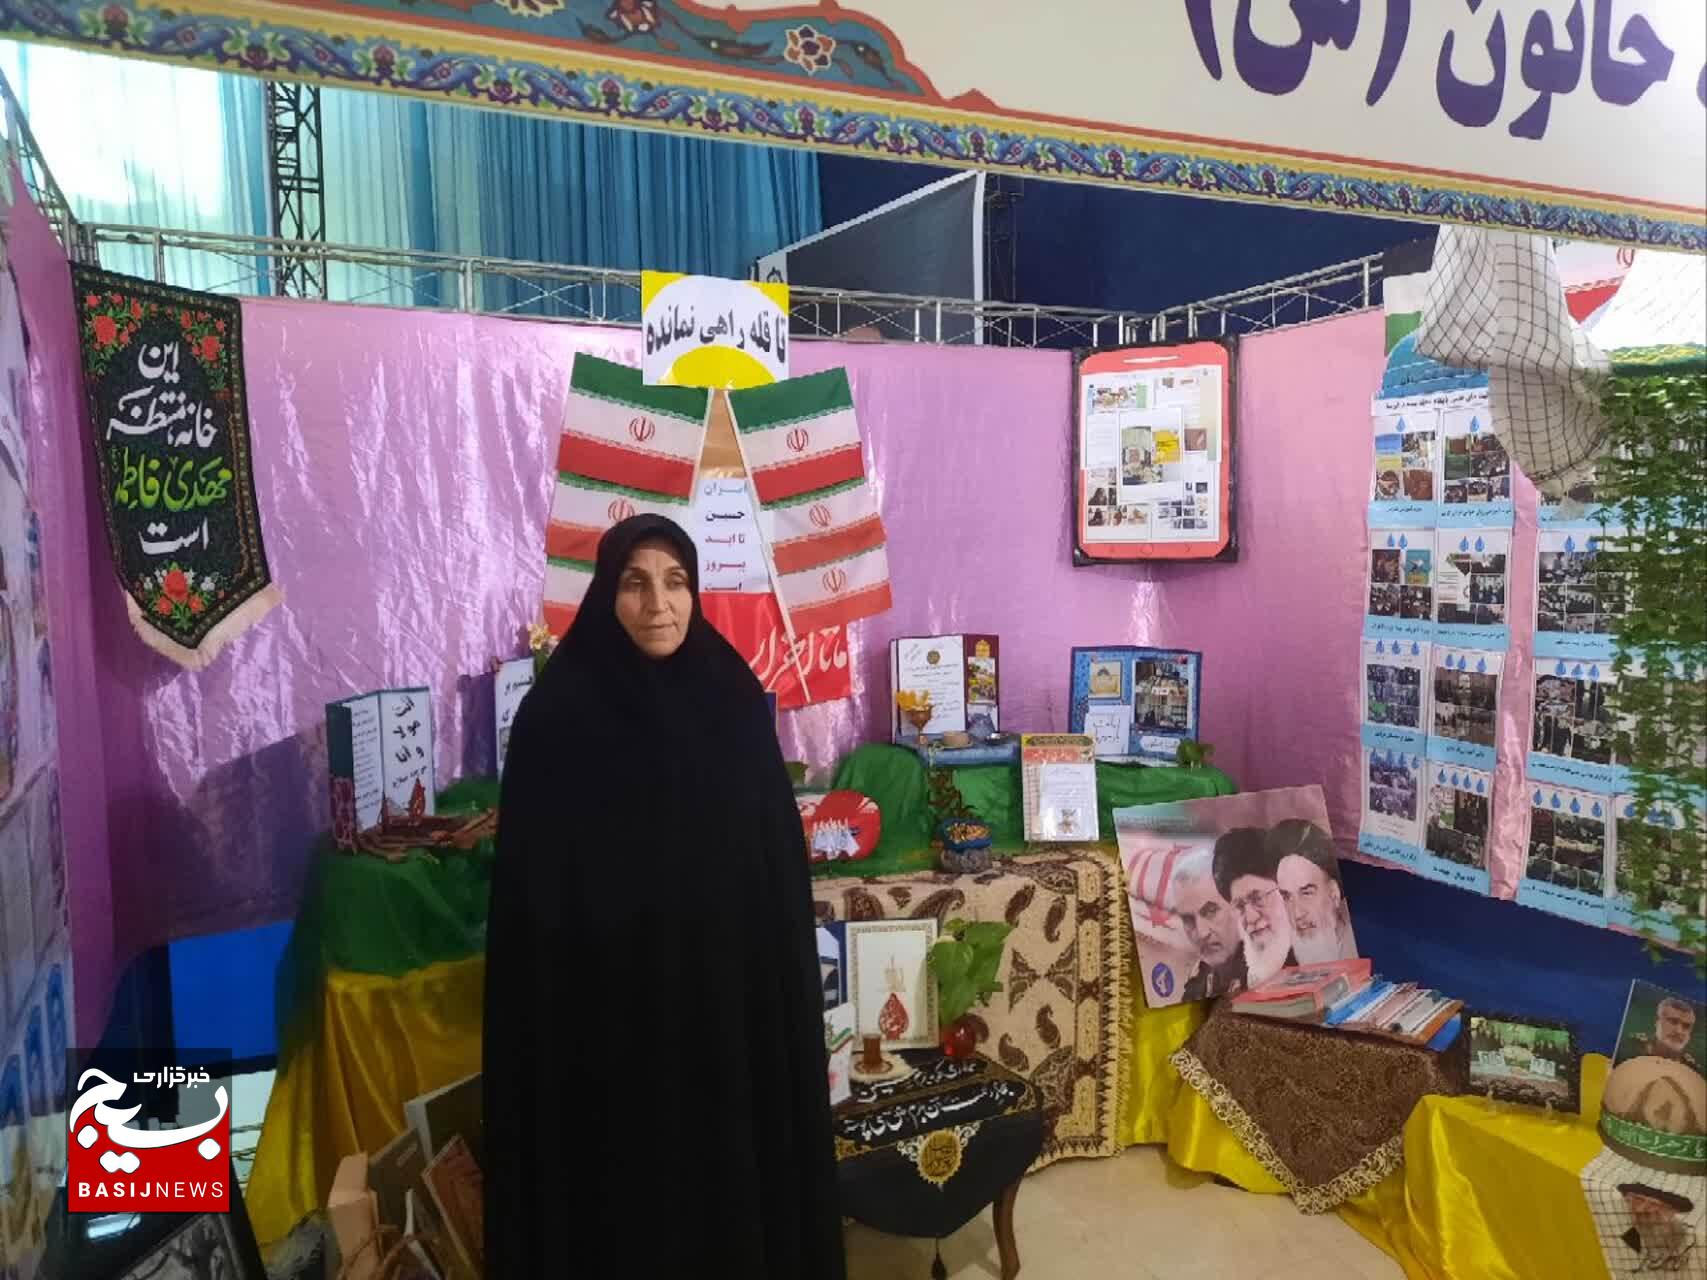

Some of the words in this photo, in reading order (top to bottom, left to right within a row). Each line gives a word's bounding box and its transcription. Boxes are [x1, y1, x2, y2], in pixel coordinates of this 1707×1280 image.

[646, 304, 695, 356] نمانده
[750, 310, 771, 353] قله
[775, 313, 786, 364] تا
[138, 340, 180, 384] این
[167, 399, 219, 448] خانه
[113, 446, 161, 511] فاطمه
[162, 455, 233, 512] مهدی
[138, 516, 209, 556] است
